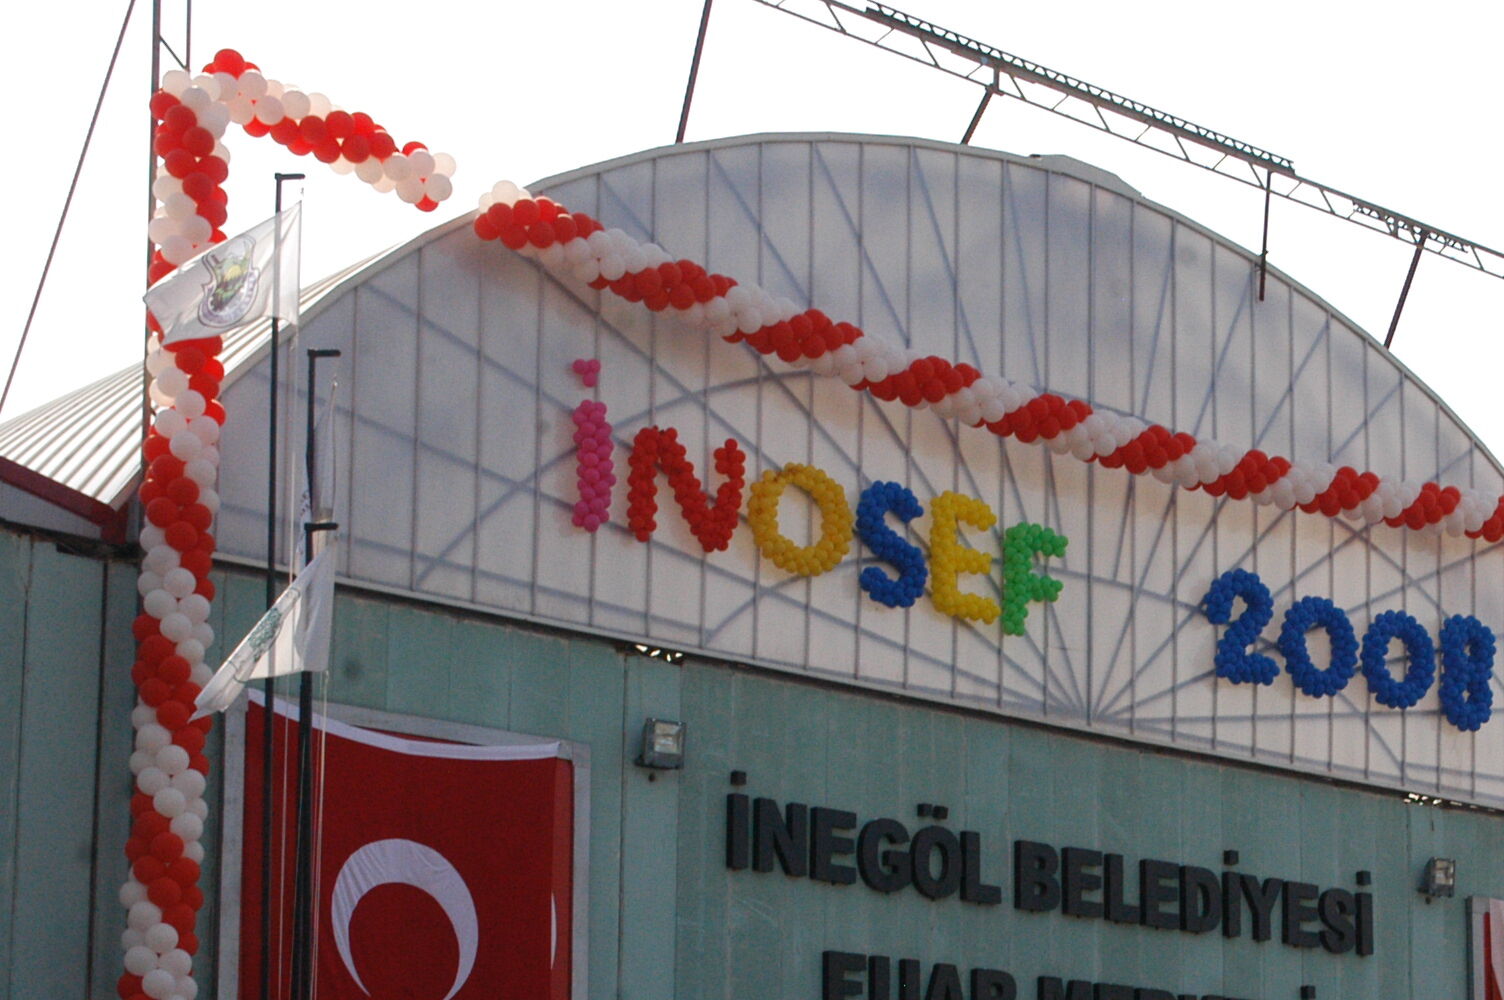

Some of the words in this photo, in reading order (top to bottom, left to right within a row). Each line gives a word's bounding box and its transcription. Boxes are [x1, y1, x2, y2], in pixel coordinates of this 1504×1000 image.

[1202, 567, 1496, 732] 2008
[725, 770, 1002, 905] İNEGÖL
[1013, 839, 1375, 957] BELEDİYESİ
